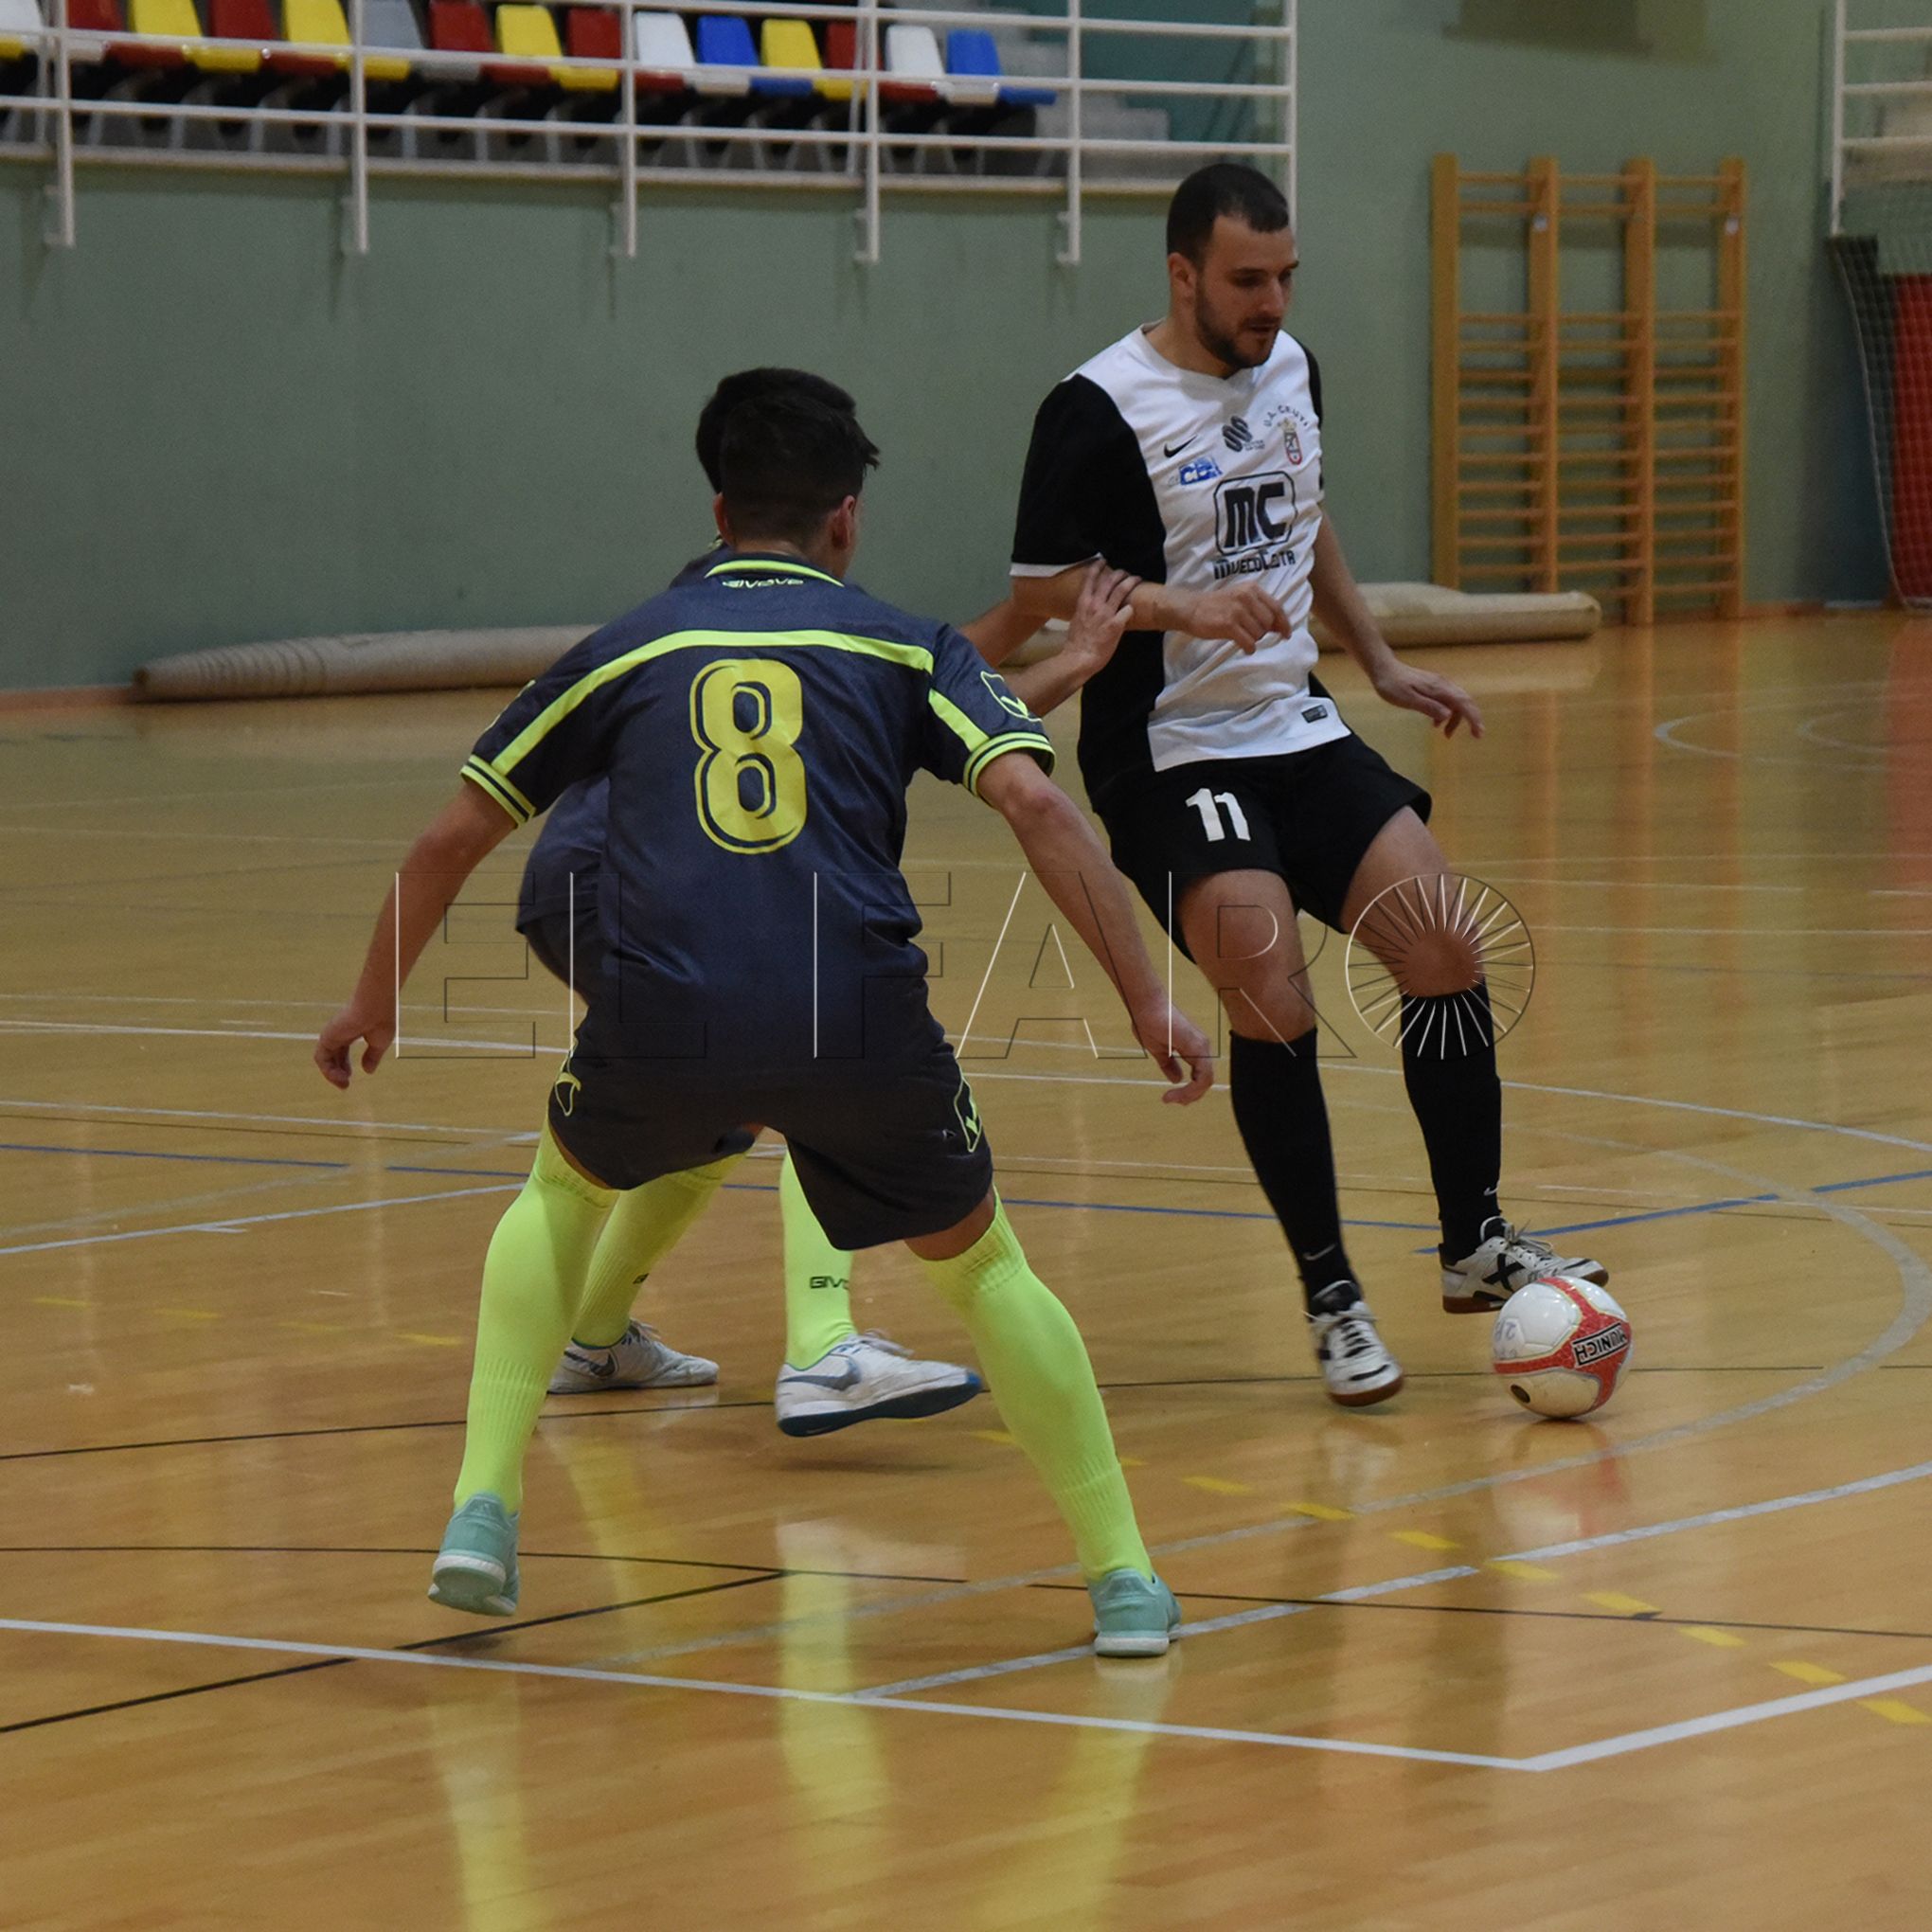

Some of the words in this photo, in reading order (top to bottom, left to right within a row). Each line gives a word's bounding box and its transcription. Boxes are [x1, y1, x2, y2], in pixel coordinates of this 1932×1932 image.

[1223, 481, 1288, 548] MC
[689, 658, 807, 854] 8
[1185, 787, 1251, 842] 11
[1574, 1326, 1627, 1360] MUNICH
